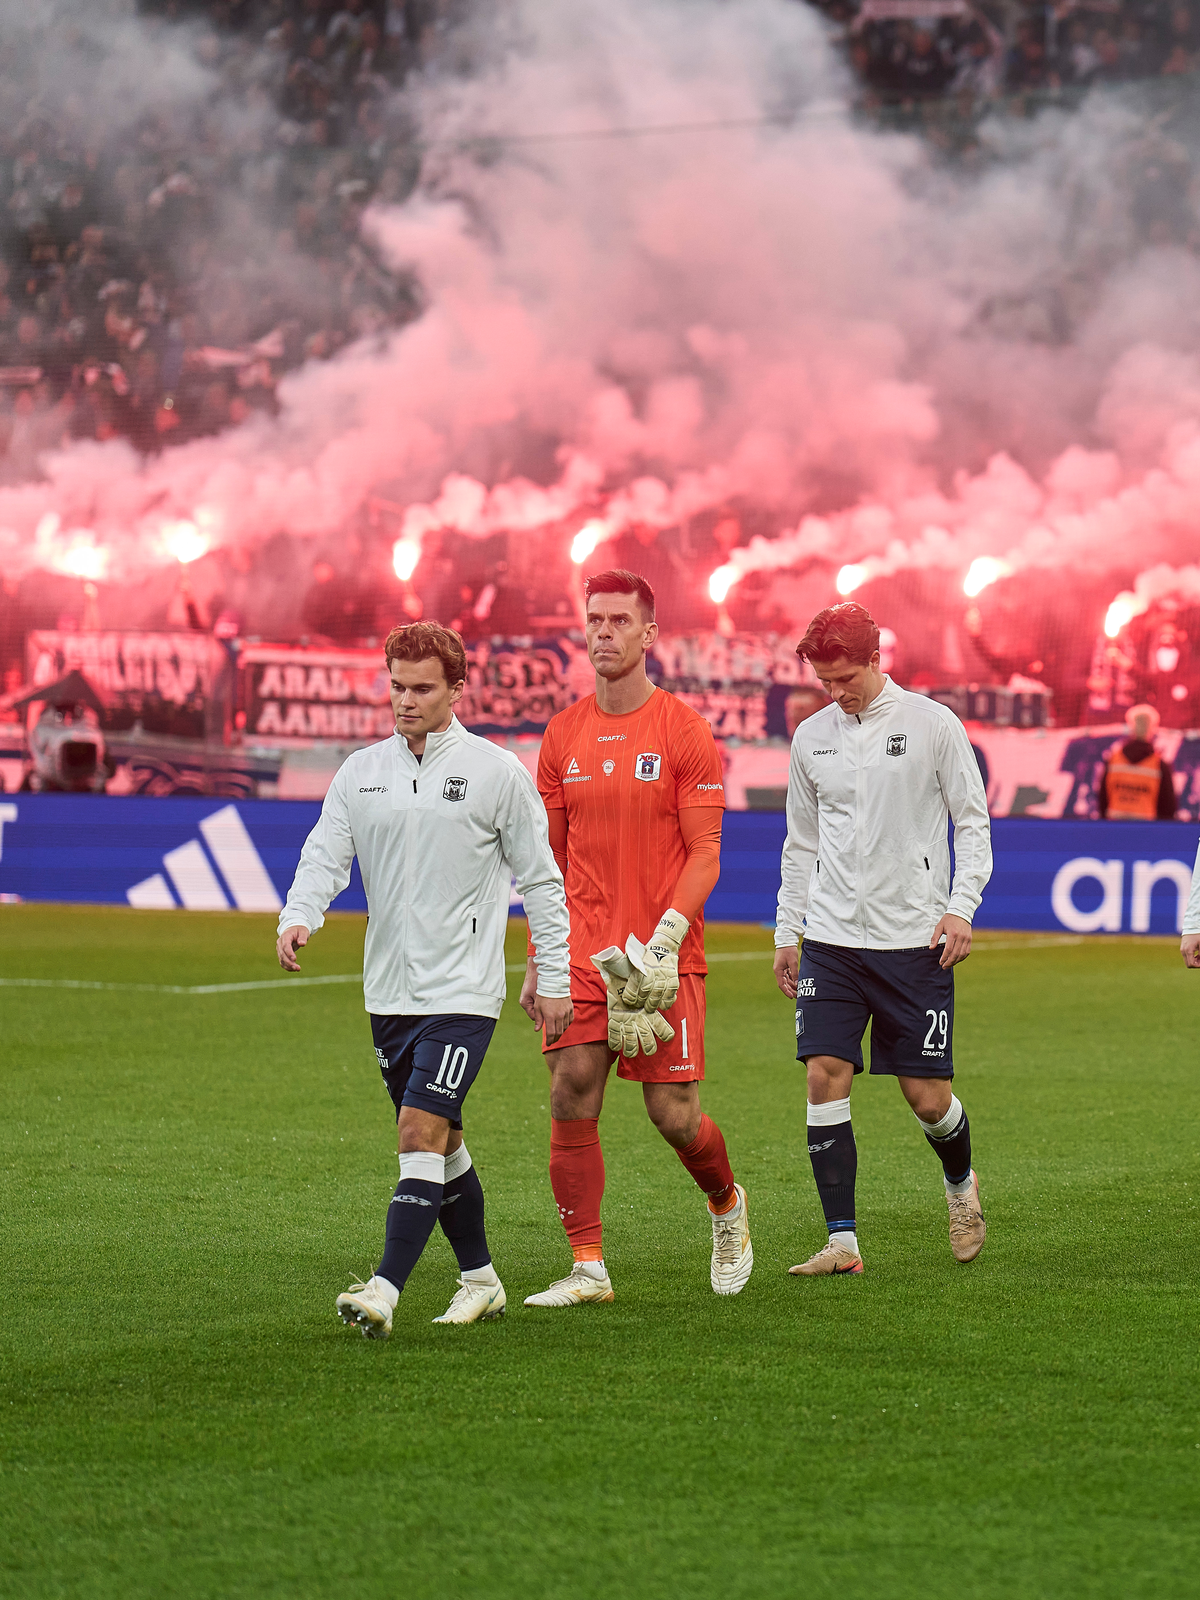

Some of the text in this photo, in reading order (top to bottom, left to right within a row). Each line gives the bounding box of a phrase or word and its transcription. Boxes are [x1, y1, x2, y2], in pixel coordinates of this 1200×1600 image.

[680, 1017, 689, 1059] 1
[923, 1009, 949, 1050] 29
[434, 1043, 470, 1090] 10
[921, 1050, 941, 1058] CRAFT
[426, 1083, 452, 1098] CRAFT
